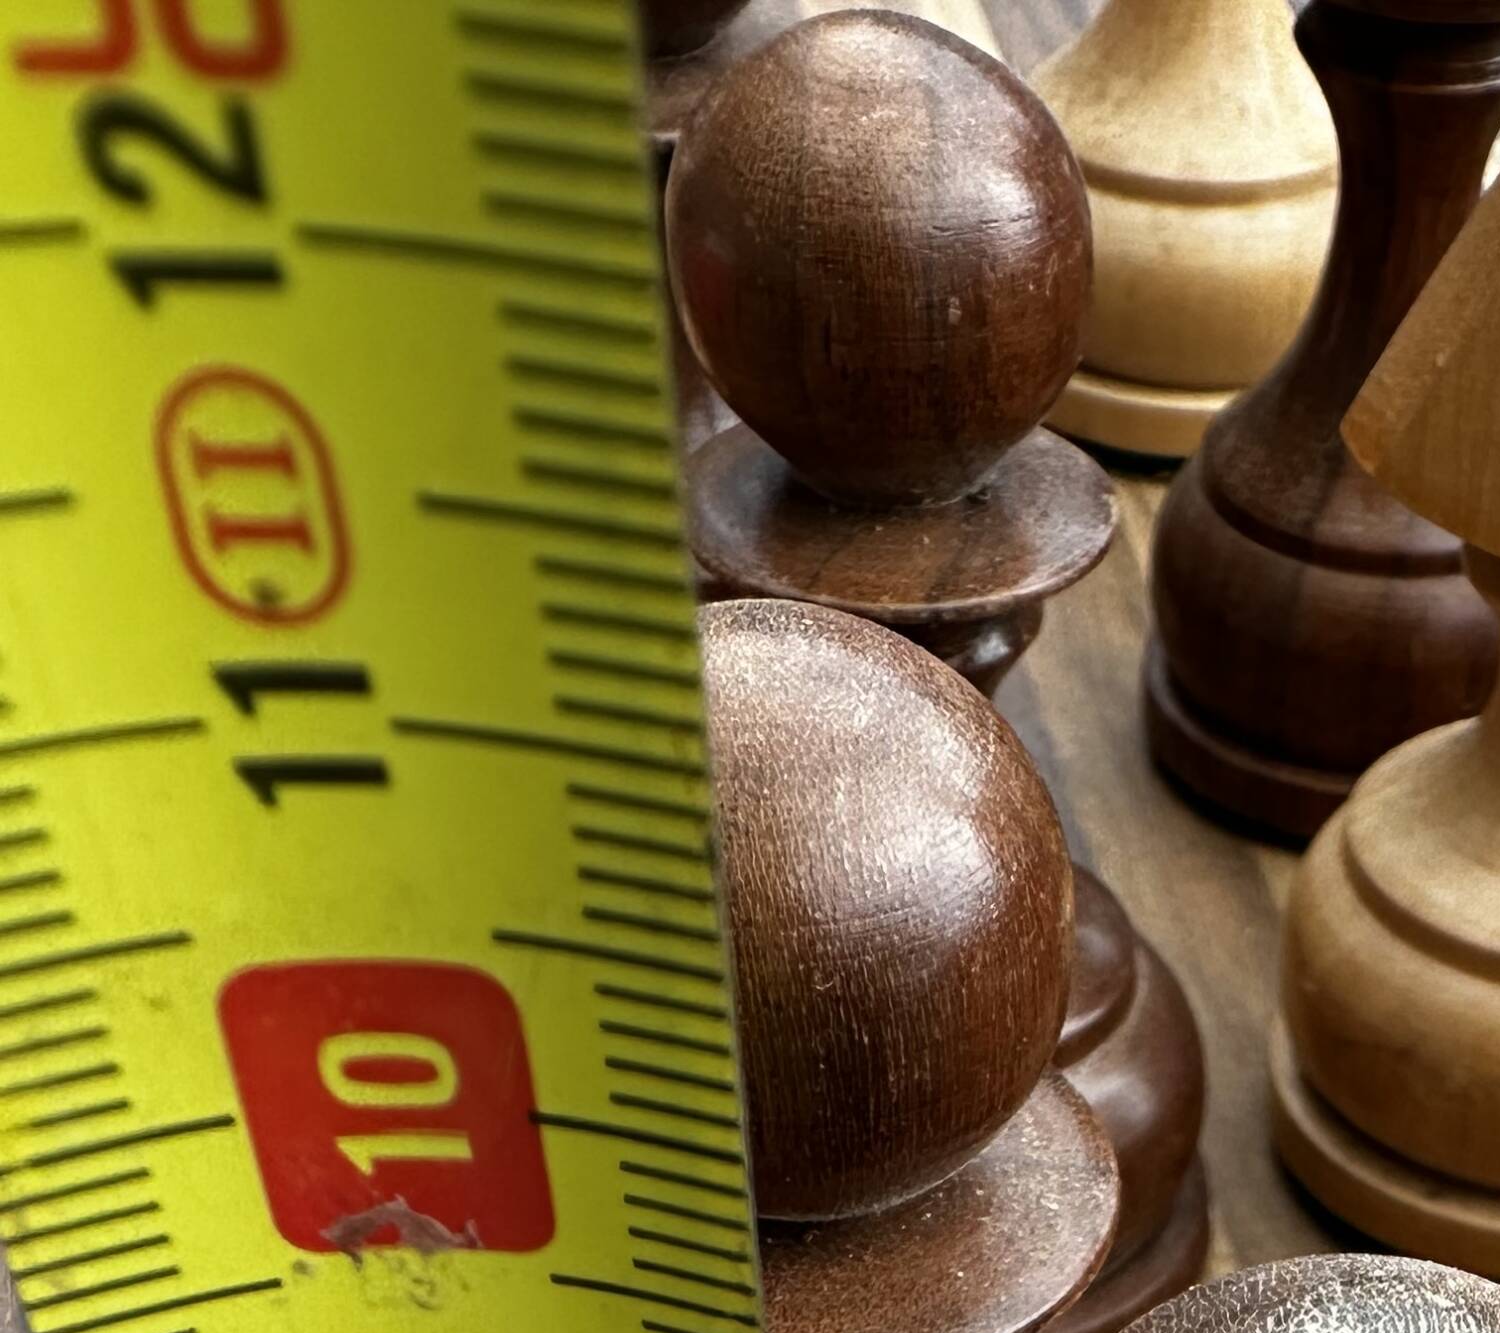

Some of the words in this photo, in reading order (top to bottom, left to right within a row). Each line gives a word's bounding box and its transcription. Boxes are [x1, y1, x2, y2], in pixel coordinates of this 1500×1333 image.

[75, 87, 289, 312] 12
[211, 660, 391, 809] 11
[317, 1032, 473, 1175] 10
